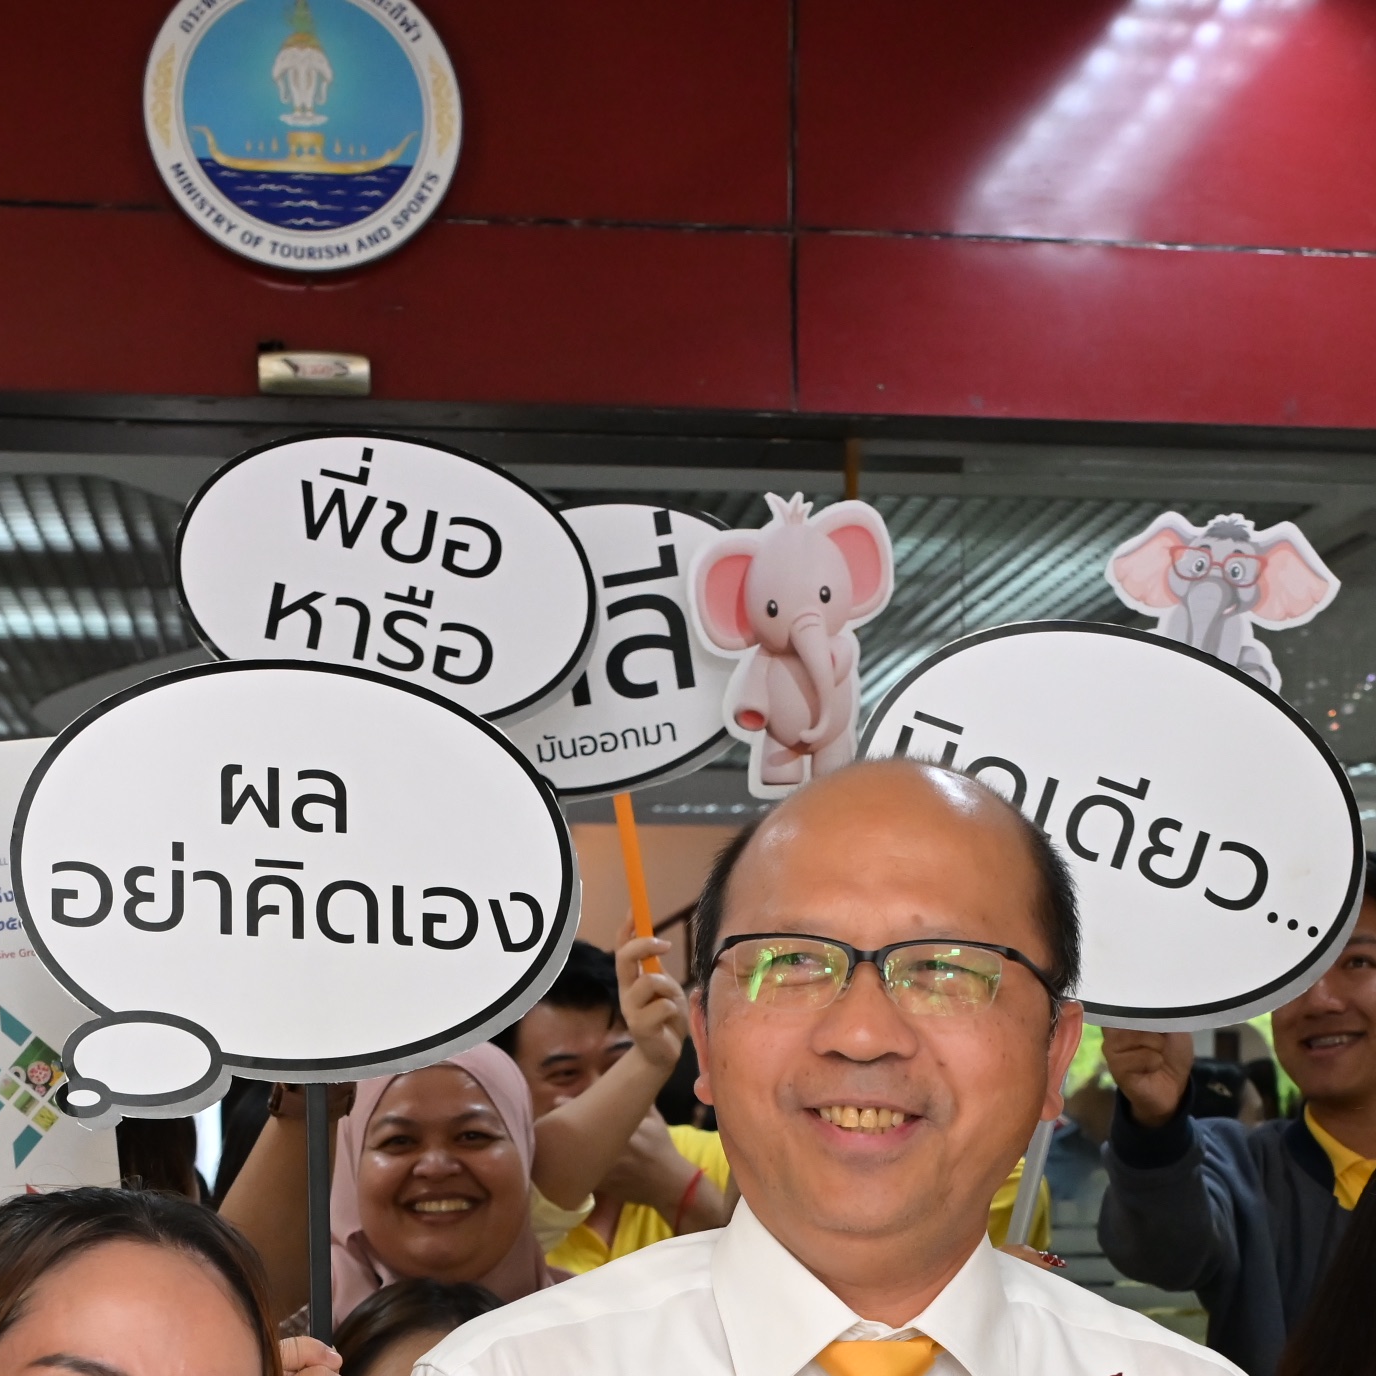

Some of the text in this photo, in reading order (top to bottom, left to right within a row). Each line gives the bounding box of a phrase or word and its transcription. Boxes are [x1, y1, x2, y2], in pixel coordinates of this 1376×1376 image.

[169, 161, 441, 261] MINISTRY OF TOURISM AND SPORTS
[299, 447, 504, 580] พี่ขอ
[262, 580, 496, 686] หารือ
[571, 509, 696, 707] ลี่
[536, 721, 678, 763] มันออกมา
[220, 762, 350, 835] ผล
[49, 842, 545, 954] อย่าคิดเอง
